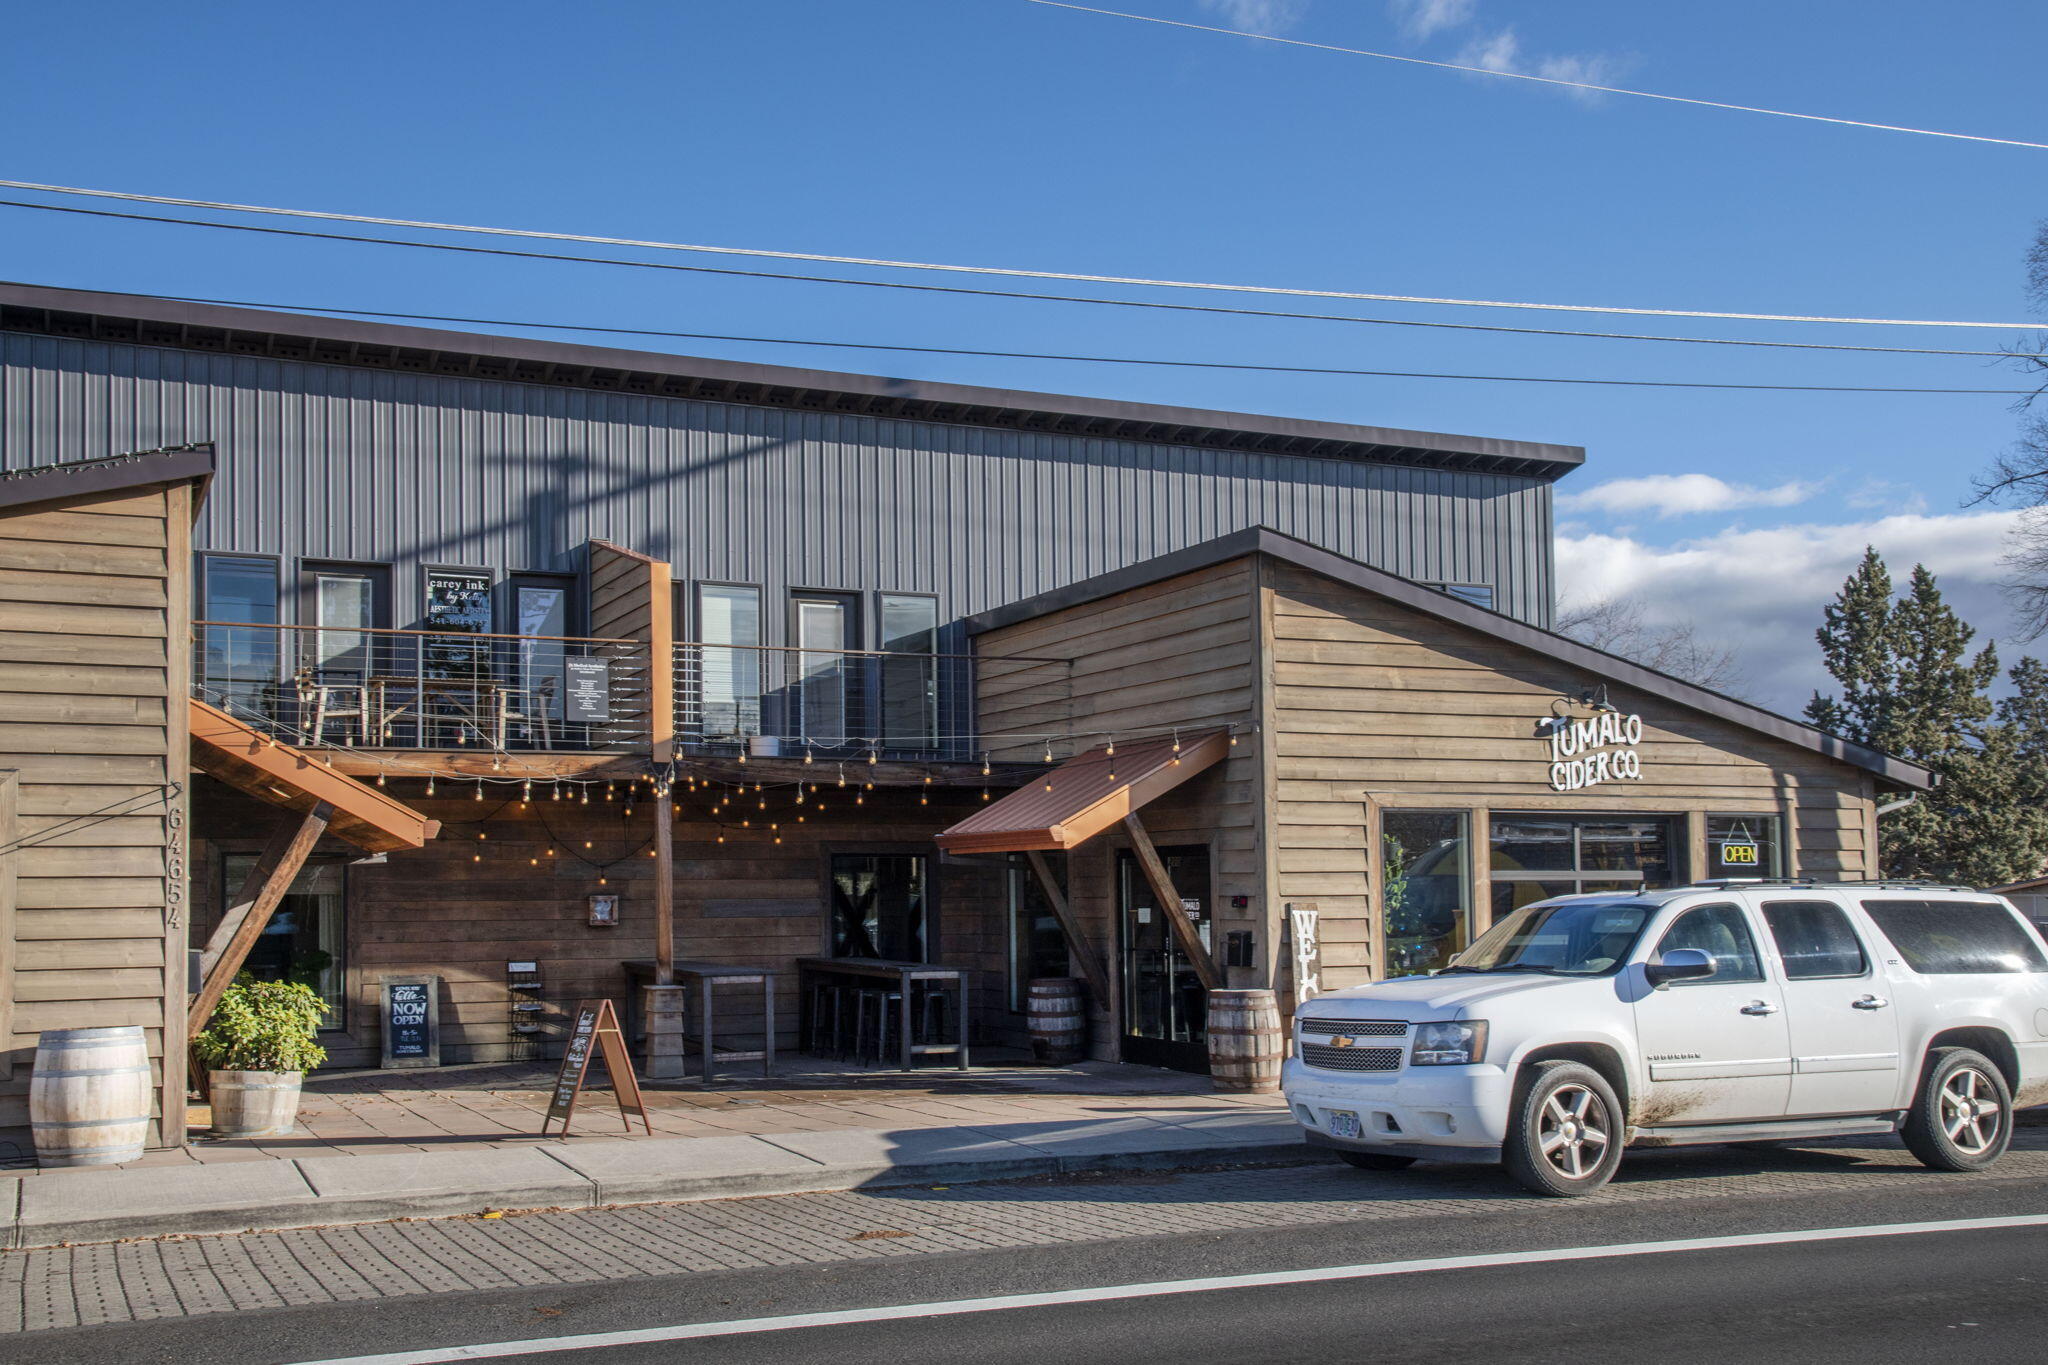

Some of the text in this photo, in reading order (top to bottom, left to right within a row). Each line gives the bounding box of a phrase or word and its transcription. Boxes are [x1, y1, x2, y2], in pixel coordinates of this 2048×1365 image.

[430, 580, 489, 591] carey ink.
[446, 591, 459, 604] by
[1541, 713, 1642, 762] TUMALO
[1552, 749, 1643, 791] CIDER CO.
[1725, 846, 1757, 862] OPEN
[167, 807, 183, 930] 64654
[393, 1003, 427, 1015] NOW
[392, 1015, 424, 1025] OPEN
